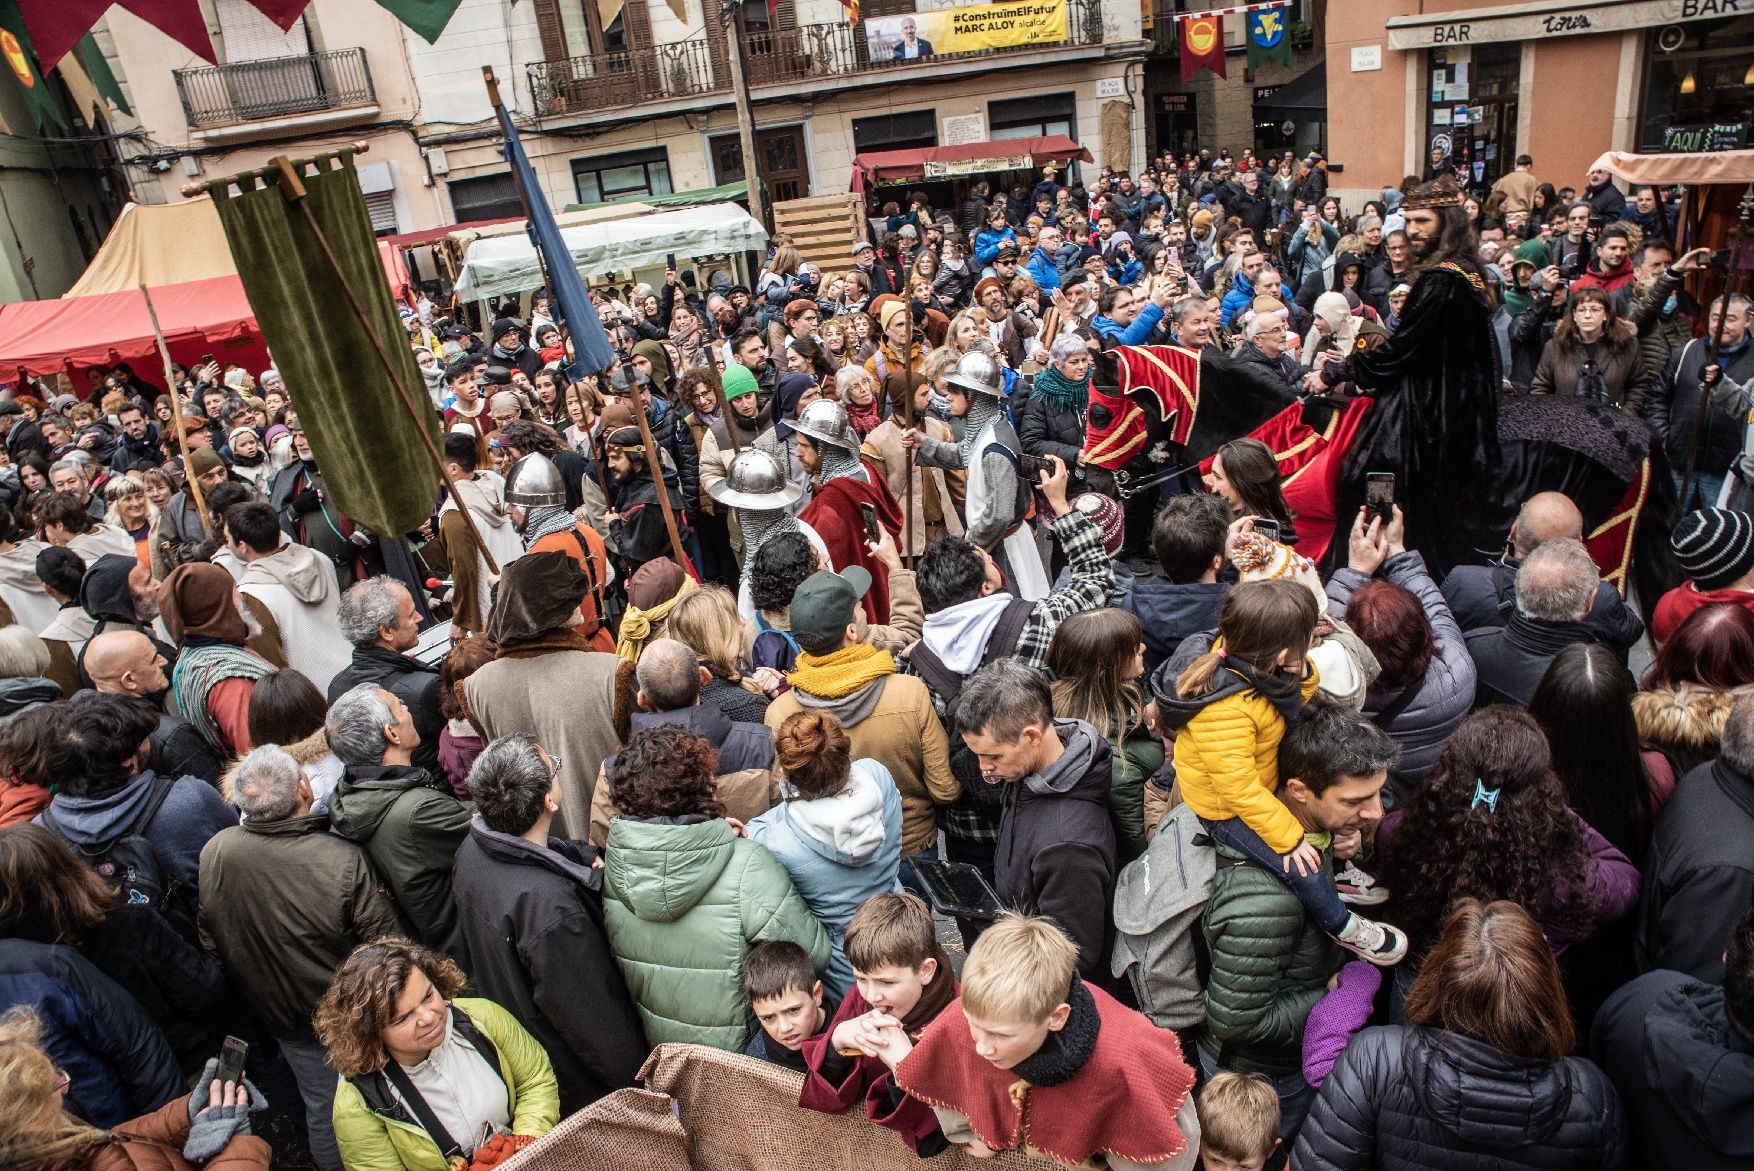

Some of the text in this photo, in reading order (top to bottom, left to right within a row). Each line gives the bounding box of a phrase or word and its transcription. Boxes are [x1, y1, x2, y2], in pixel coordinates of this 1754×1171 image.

[953, 5, 1056, 23] #ConstruïmElFutur
[1433, 24, 1470, 43] BAR
[1681, 0, 1739, 17] BAR
[954, 23, 985, 35] MARC
[987, 20, 1015, 31] ALOY
